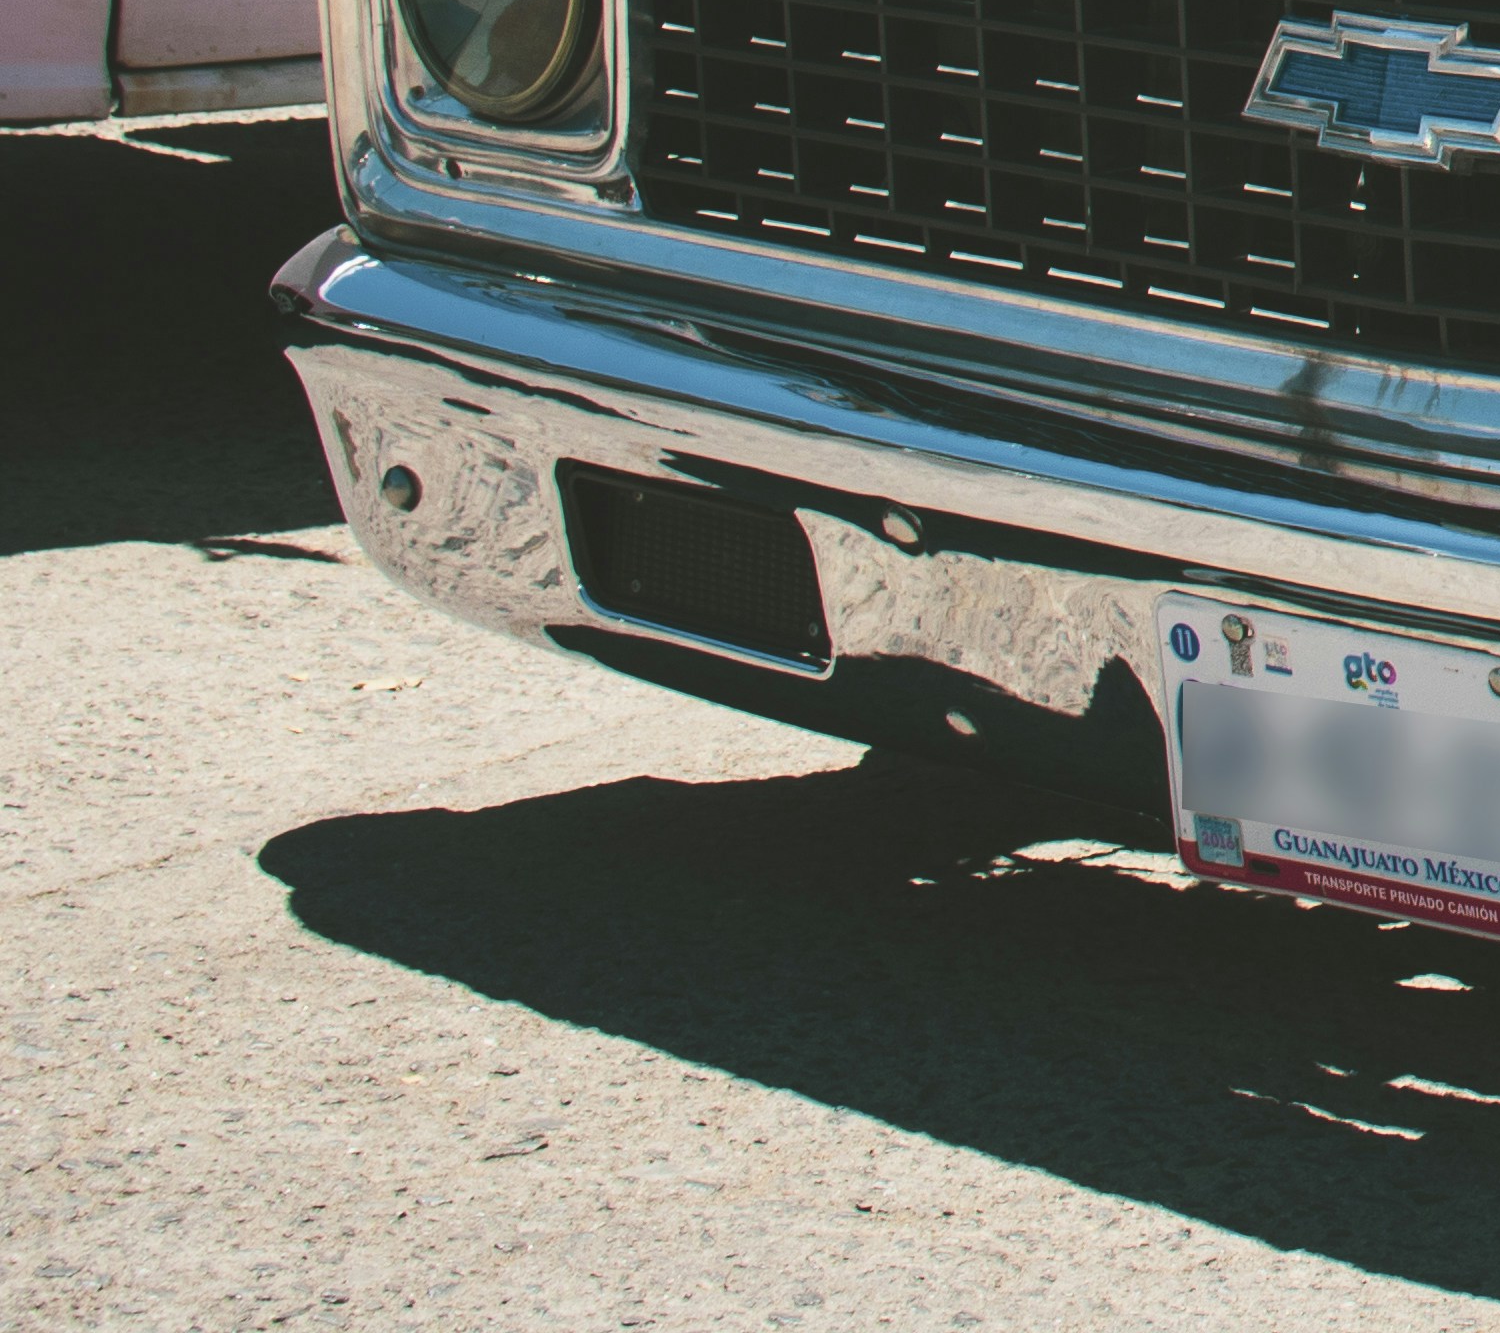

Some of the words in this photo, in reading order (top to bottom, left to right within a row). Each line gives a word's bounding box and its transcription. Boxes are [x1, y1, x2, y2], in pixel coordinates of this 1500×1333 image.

[1344, 652, 1397, 690] gto
[1274, 828, 1419, 876] GUANAJUATO
[1304, 871, 1387, 900] TRANSPORTE
[1390, 889, 1445, 912] PRIVADO
[1448, 901, 1499, 923] CAMIÓN
